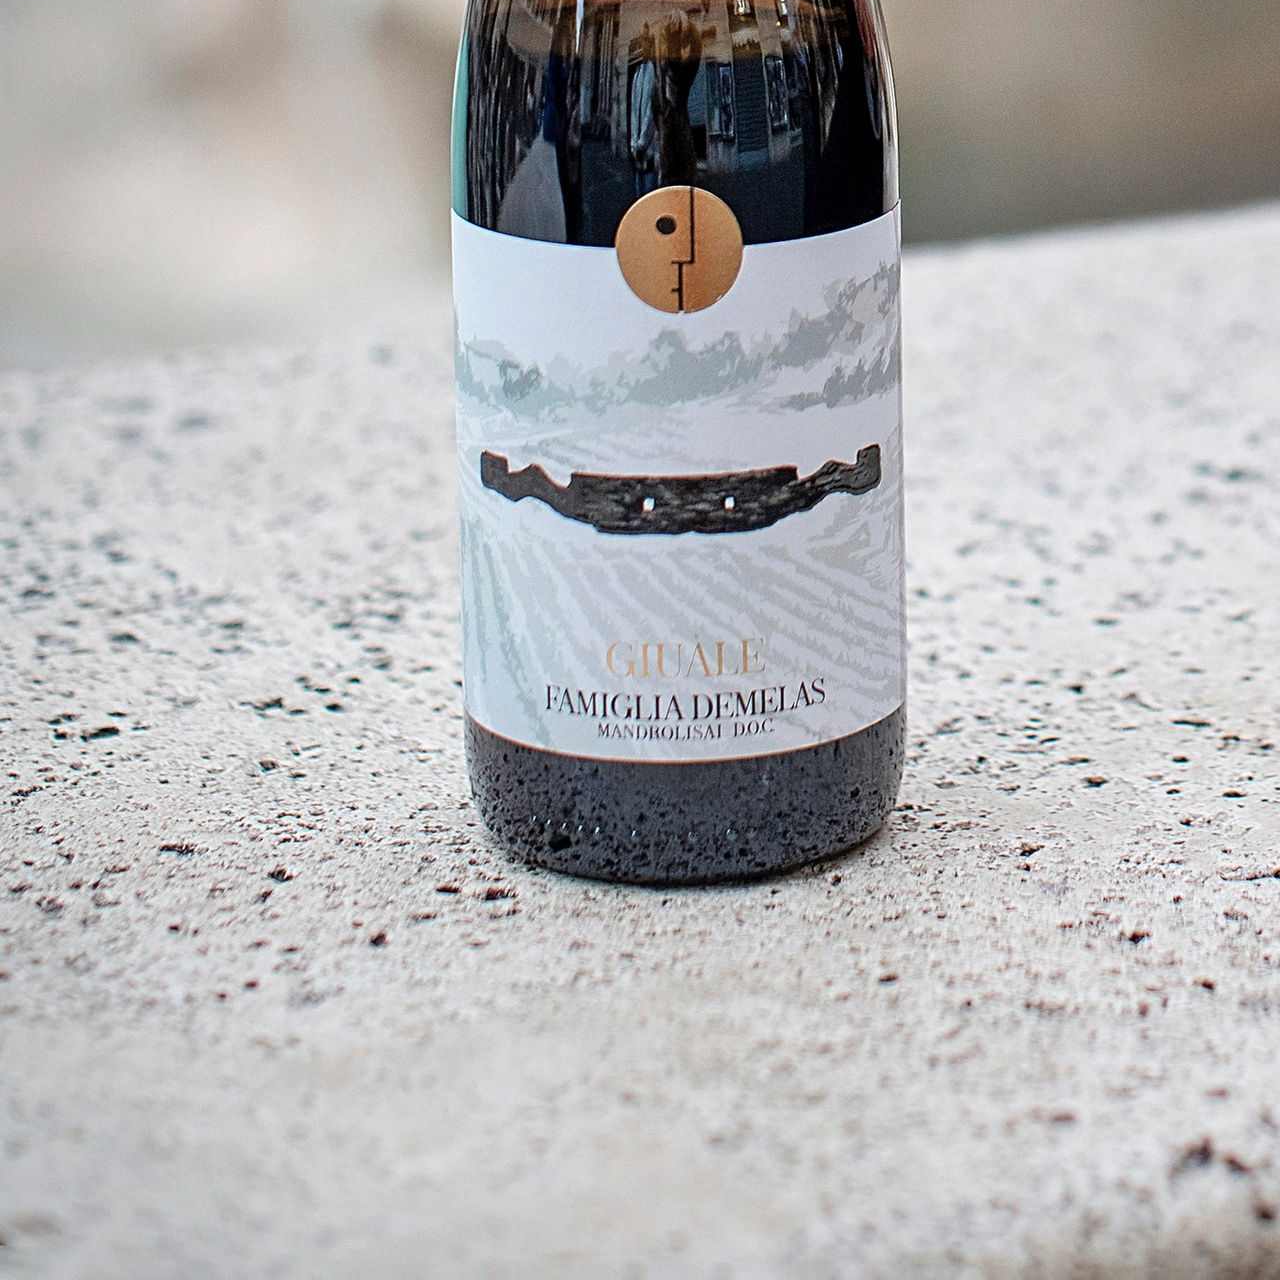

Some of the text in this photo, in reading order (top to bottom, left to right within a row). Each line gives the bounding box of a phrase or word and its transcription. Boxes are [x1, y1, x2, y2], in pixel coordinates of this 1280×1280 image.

[546, 678, 827, 721] FAMIGLIA DEMELAS
[598, 718, 775, 740] MANDROLISAI D.O.C.
